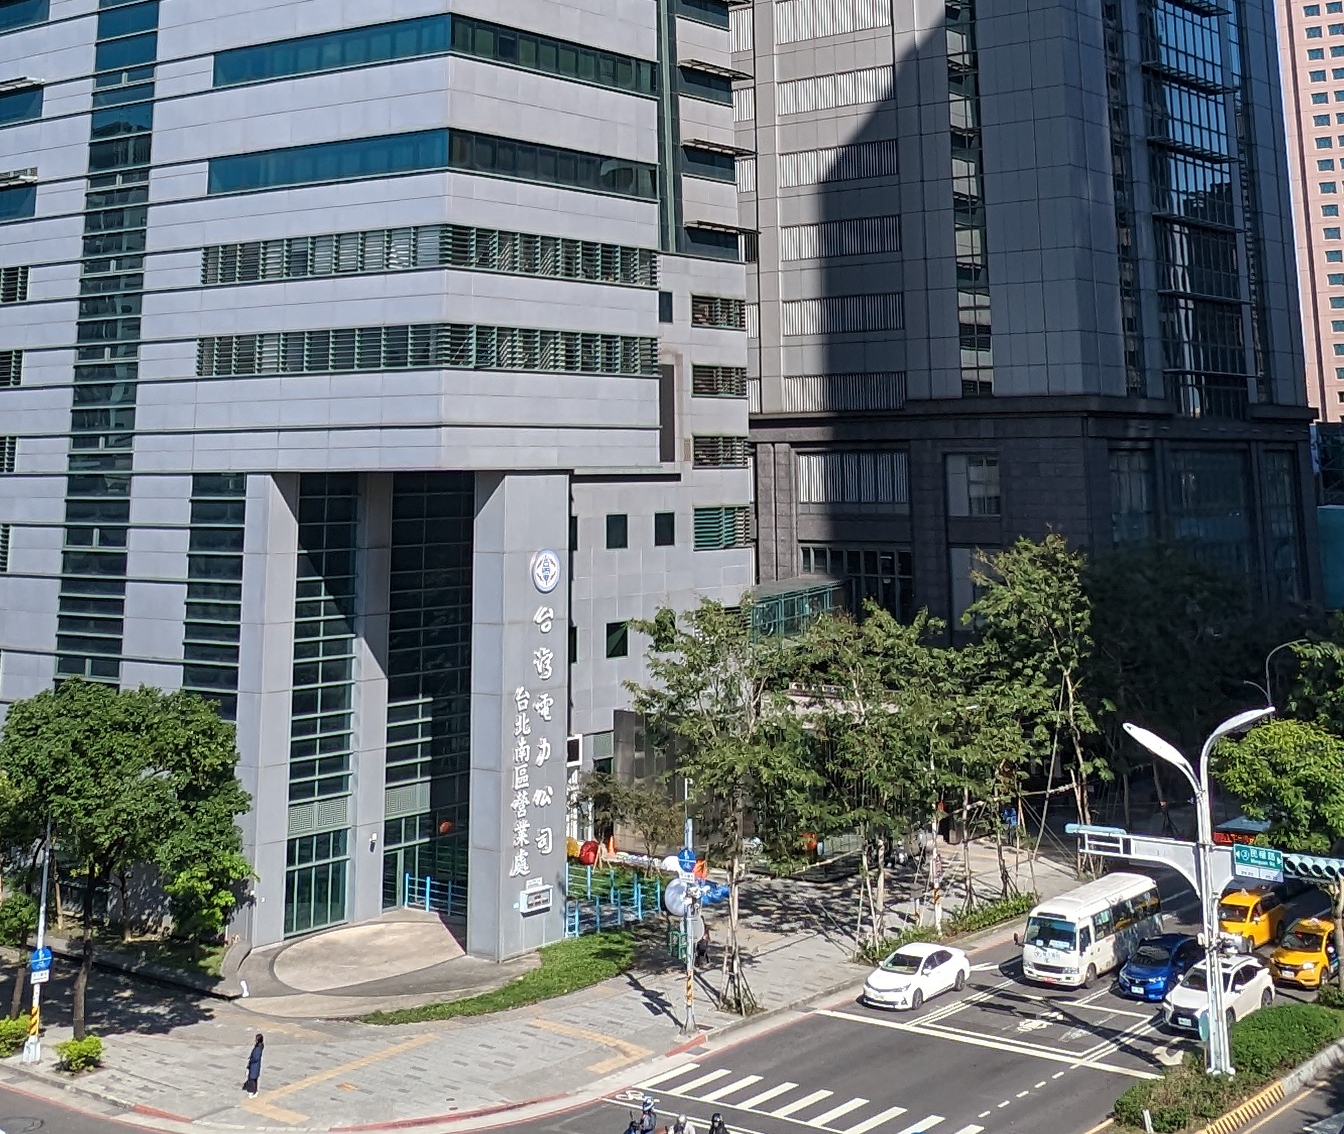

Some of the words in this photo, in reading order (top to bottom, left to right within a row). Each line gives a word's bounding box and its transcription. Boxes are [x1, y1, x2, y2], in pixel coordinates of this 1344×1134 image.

[510, 685, 532, 878] 台北南區營業處
[532, 605, 554, 854] 台灣電力公司
